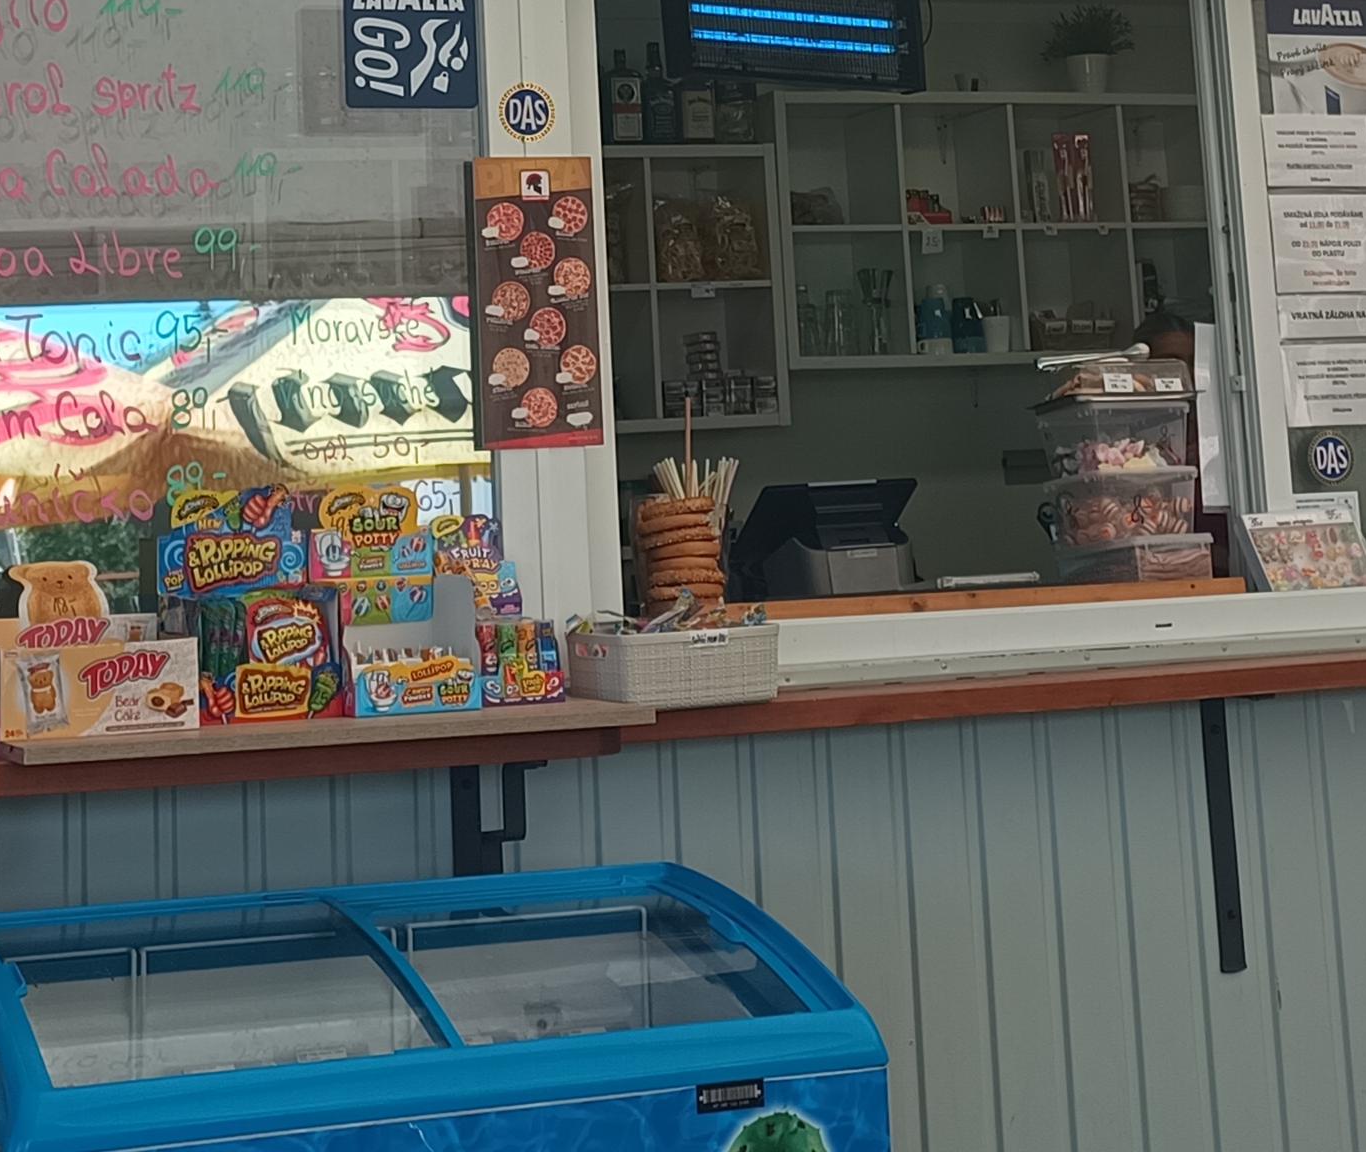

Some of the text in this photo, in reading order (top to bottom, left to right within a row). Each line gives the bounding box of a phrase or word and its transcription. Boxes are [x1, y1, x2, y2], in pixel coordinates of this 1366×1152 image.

[1292, 3, 1363, 27] LAVAZZA
[508, 97, 547, 132] DAS
[46, 144, 220, 198] Colada
[70, 235, 184, 280] Libre
[1291, 309, 1324, 321] VRATNÁ
[1325, 308, 1355, 321] ZÁLOHA
[5, 313, 142, 366] Tonic
[55, 391, 158, 440] Cola
[373, 434, 430, 465] 50,-
[1315, 441, 1349, 475] DAS
[352, 516, 399, 533] SOUR
[355, 532, 400, 547] POTTY
[199, 537, 276, 567] POPPING
[451, 547, 492, 559] FRUIT
[193, 560, 264, 588] LOLLIPOP
[18, 617, 111, 648] TODAY
[79, 650, 171, 699] TODAY
[411, 662, 454, 682] LOLLIPOP
[115, 695, 142, 708] Bear
[115, 709, 141, 722] Cake
